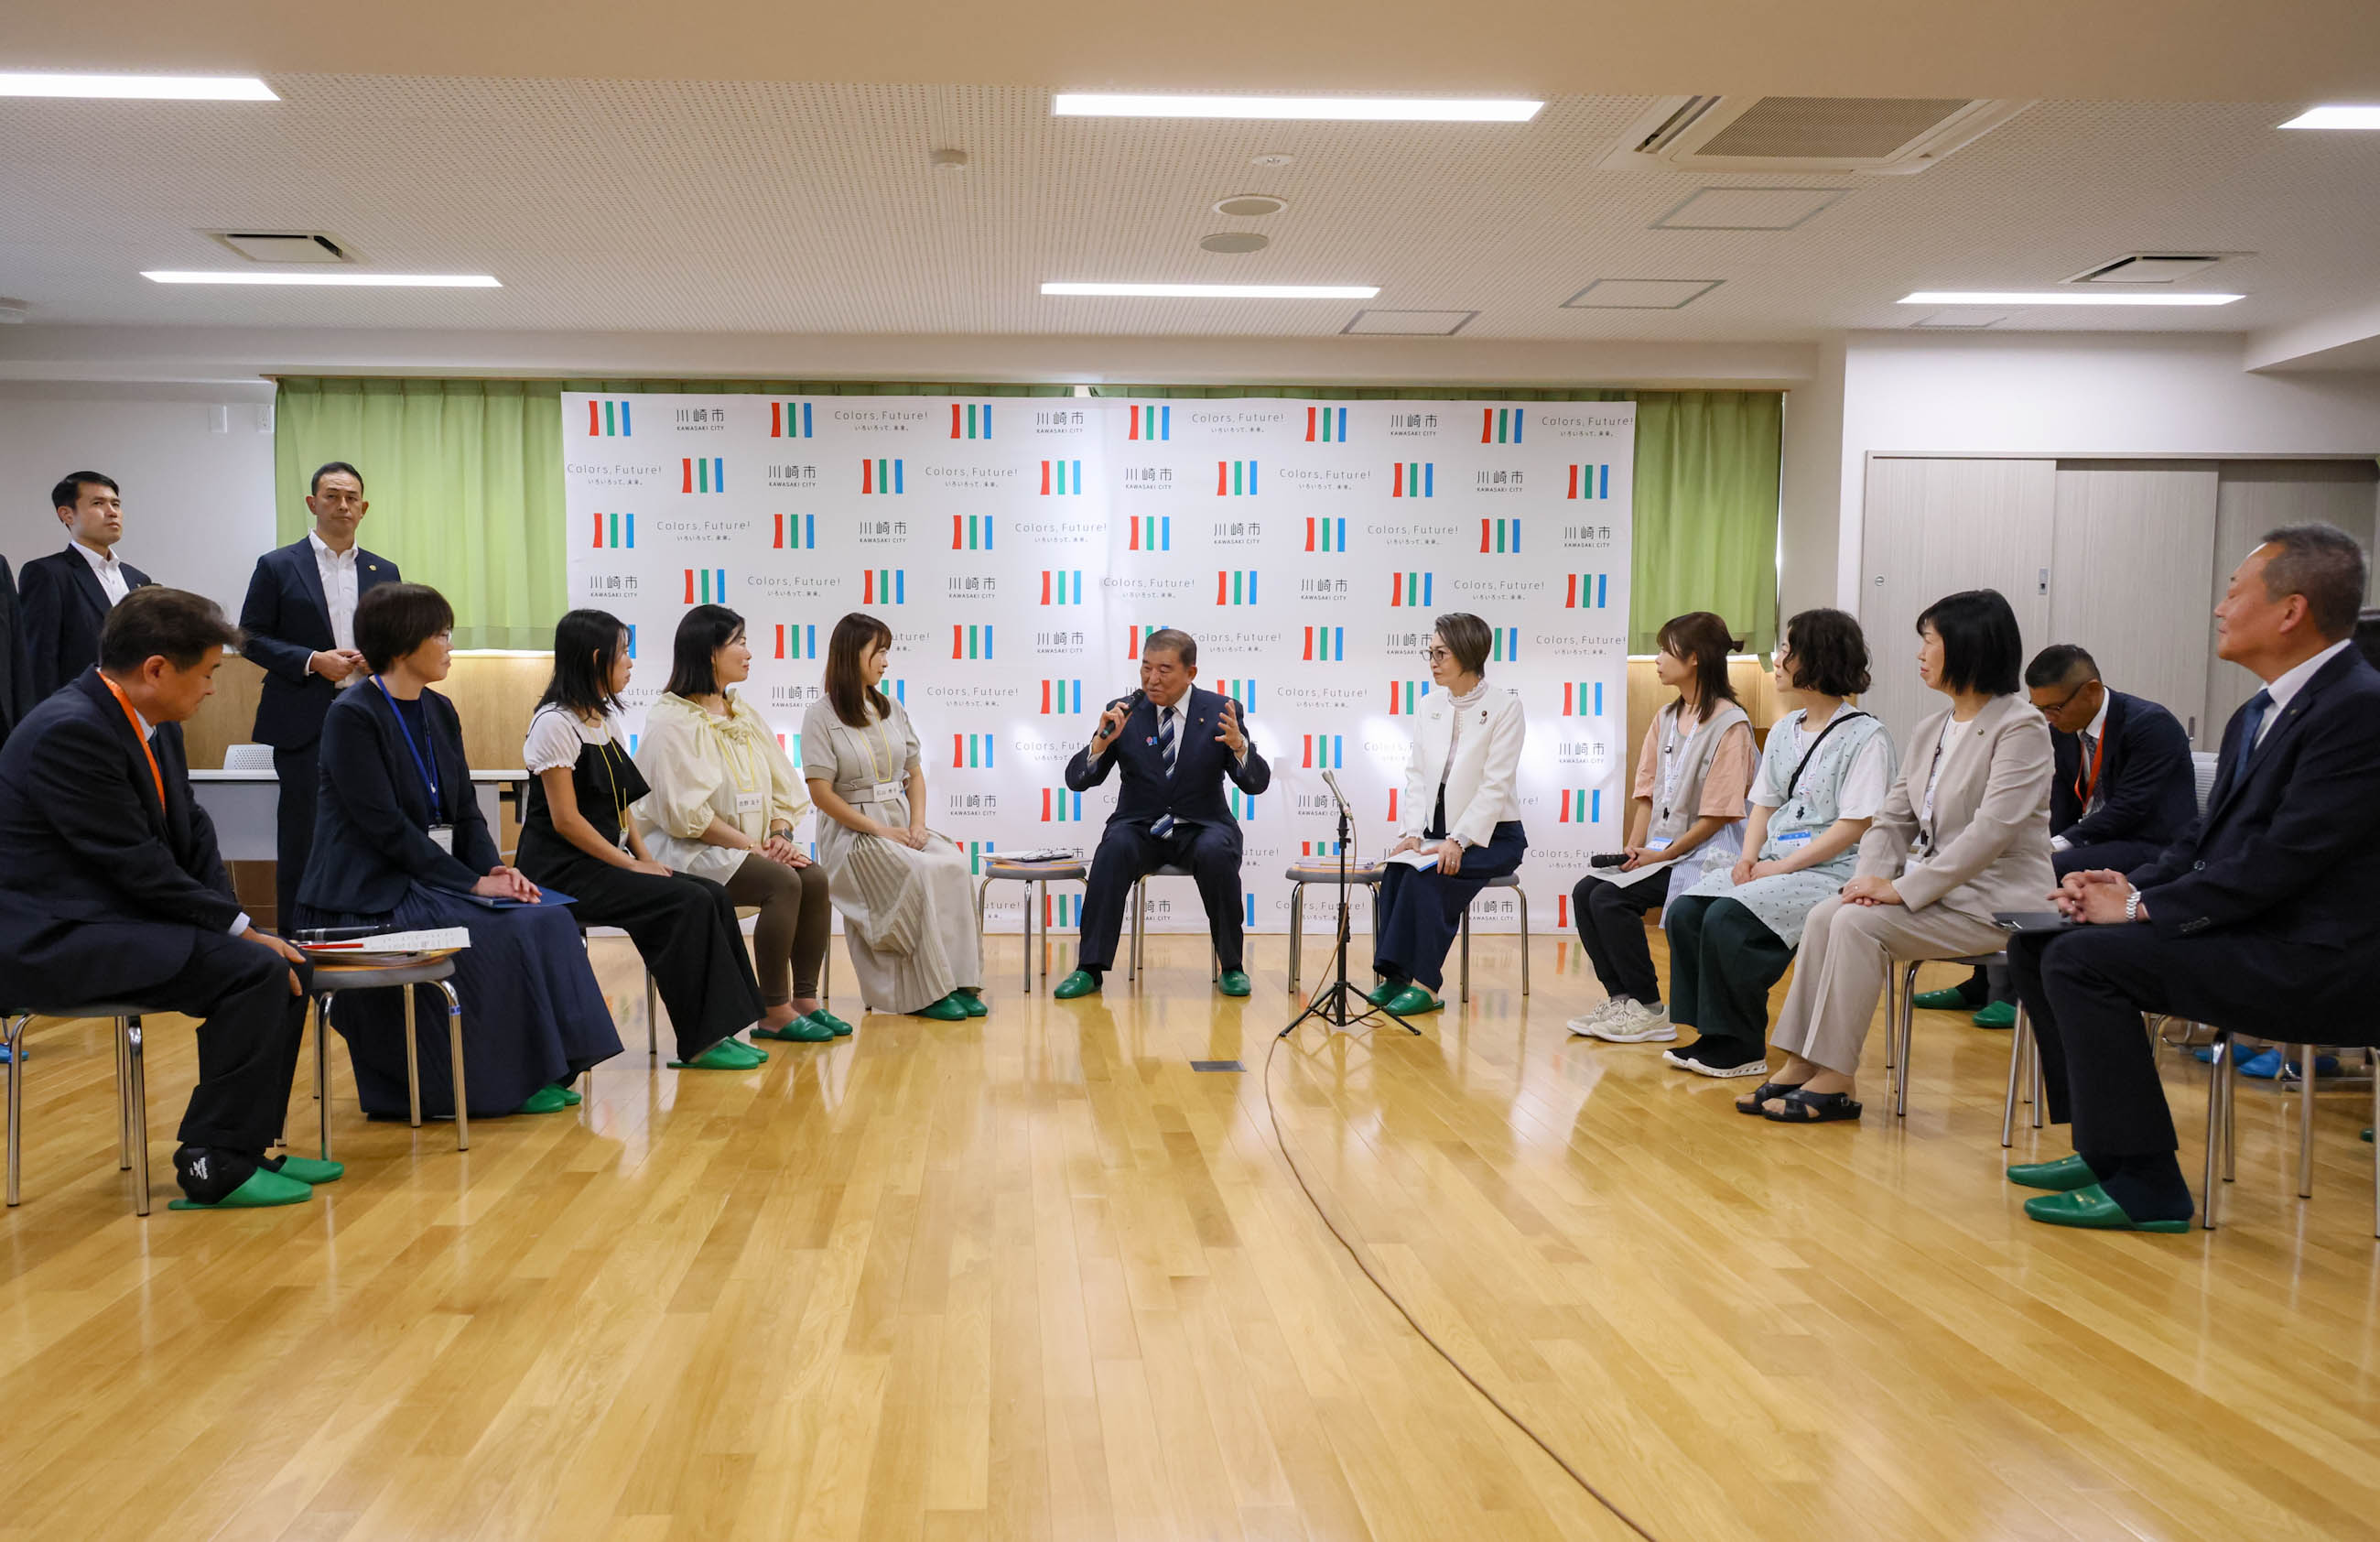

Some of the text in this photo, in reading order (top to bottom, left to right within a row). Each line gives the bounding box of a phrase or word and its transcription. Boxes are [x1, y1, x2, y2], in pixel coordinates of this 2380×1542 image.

[677, 408, 724, 422] 川崎市
[882, 411, 927, 420] Future!
[1037, 412, 1084, 425] 川崎市
[1239, 413, 1283, 422] Future!
[1391, 415, 1438, 428] 川崎市
[1587, 418, 1633, 427] Future!
[615, 465, 661, 475] Future!
[769, 465, 817, 478] 川崎市
[972, 468, 1017, 477] Future!
[1126, 468, 1173, 481] 川崎市
[1325, 471, 1369, 480] Future!
[1477, 471, 1524, 483] 川崎市
[704, 521, 750, 530] Future!
[860, 521, 907, 535] 川崎市
[1061, 524, 1106, 532] Future!
[1215, 523, 1260, 536] 川崎市
[1413, 526, 1457, 535] Future!
[1565, 527, 1611, 539] 川崎市
[590, 576, 638, 589] 川崎市
[794, 577, 839, 587] Future!
[949, 577, 996, 590] 川崎市
[1150, 579, 1194, 588] Future!
[1302, 579, 1348, 592] 川崎市
[1499, 581, 1543, 591] Future!
[892, 632, 930, 641] uture!
[1038, 632, 1084, 645] 川崎市
[1236, 633, 1281, 642] Future!
[1387, 633, 1433, 646] 川崎市
[1581, 635, 1626, 646] Future!
[773, 686, 818, 699] 川崎市
[973, 688, 1018, 697] Future!
[1323, 689, 1367, 698] Future!
[1560, 743, 1605, 755] 川崎市
[951, 795, 997, 808] 川崎市
[984, 901, 1021, 909] uture!
[1276, 901, 1365, 911] Cors, Fure!
